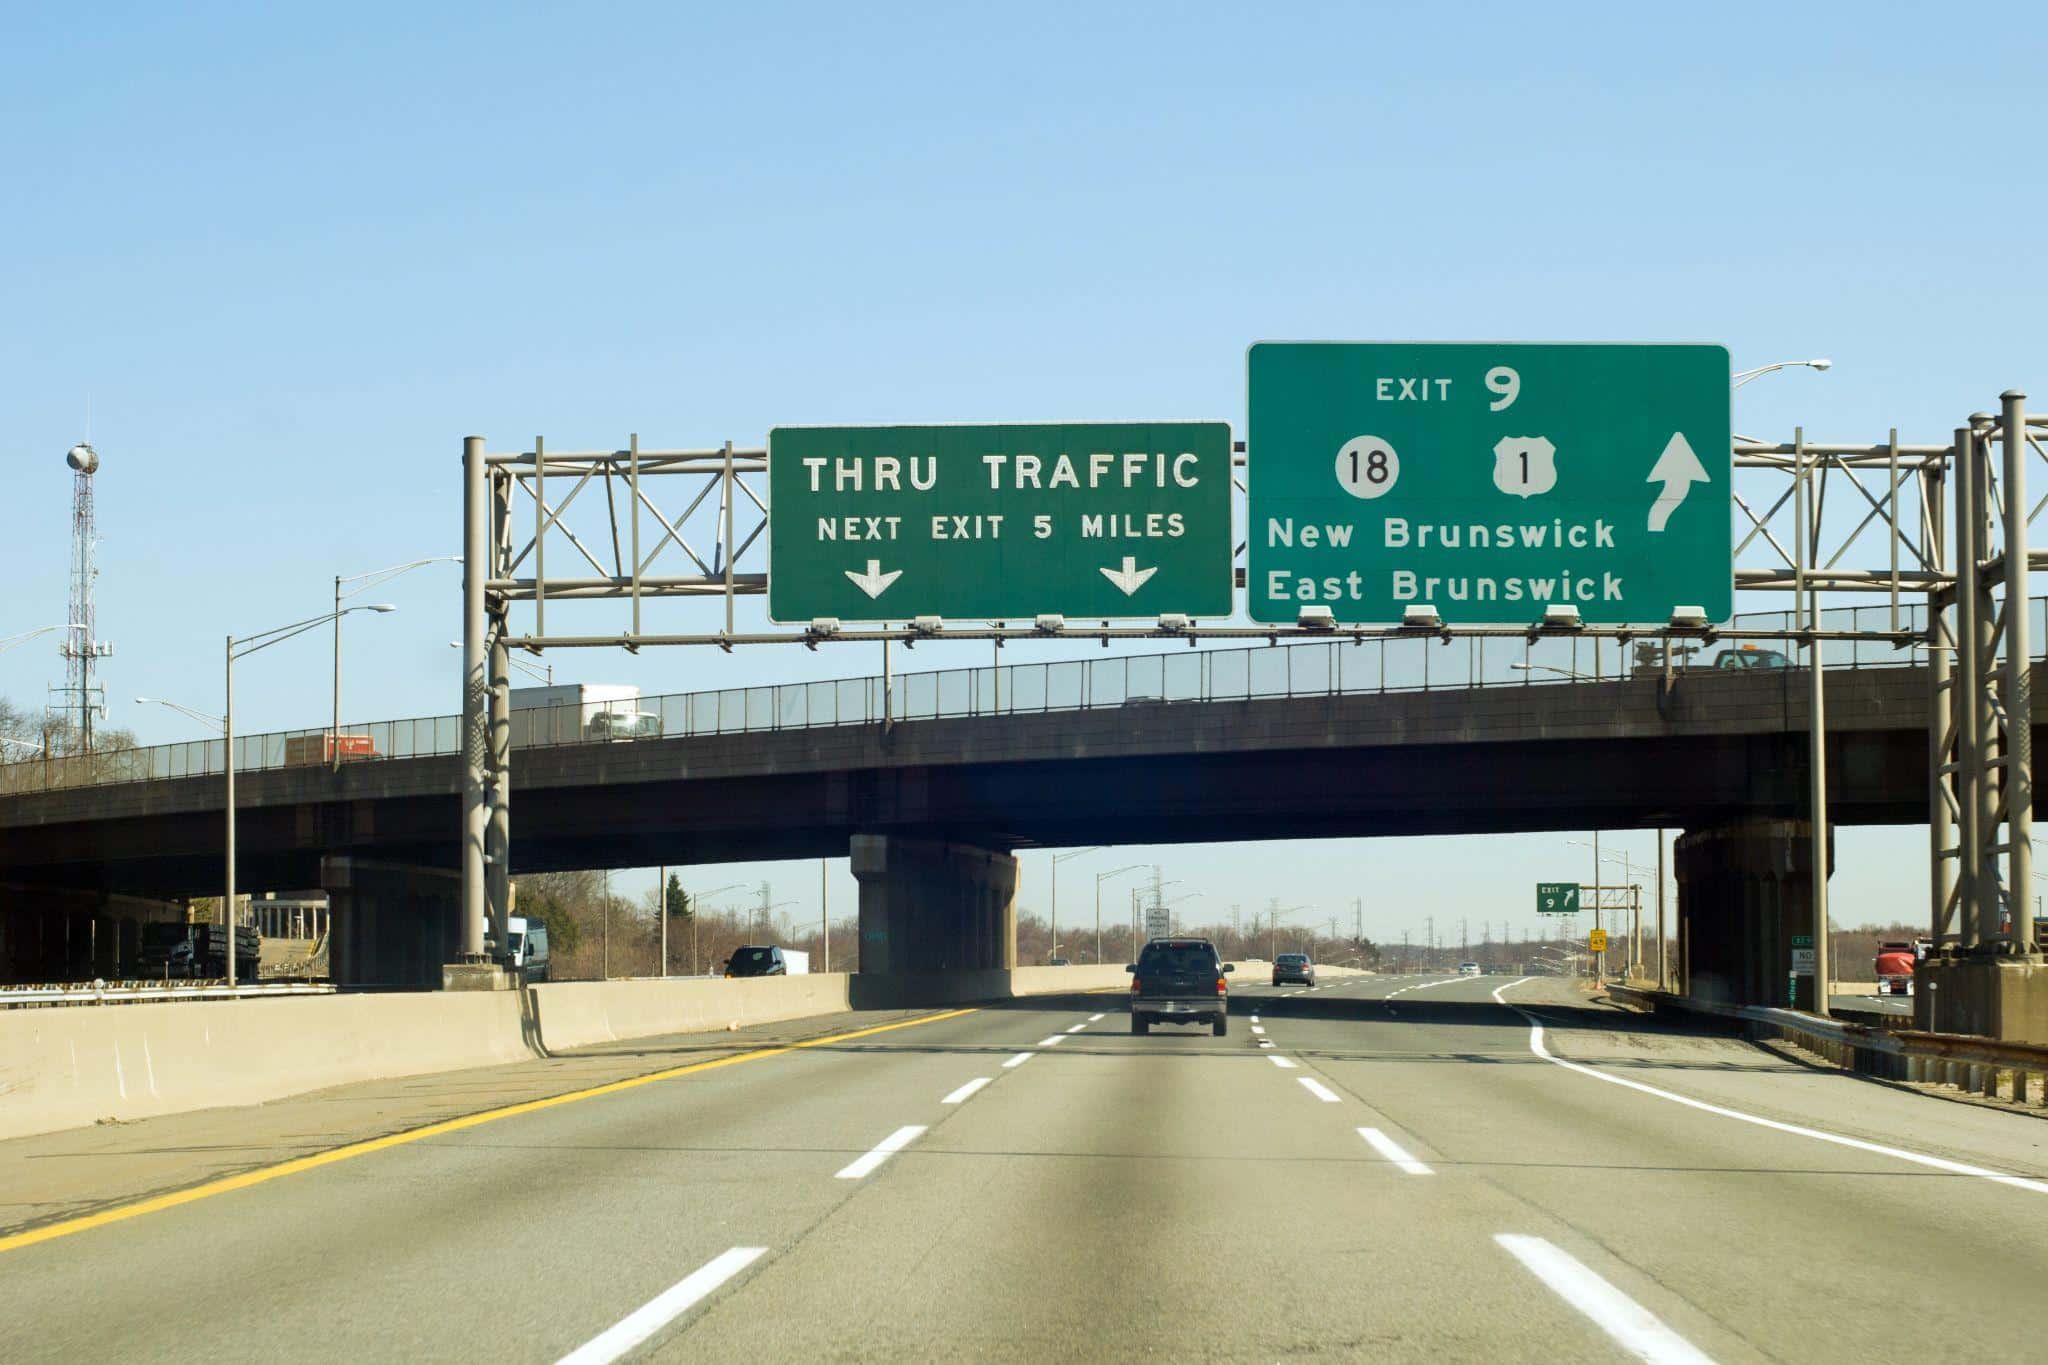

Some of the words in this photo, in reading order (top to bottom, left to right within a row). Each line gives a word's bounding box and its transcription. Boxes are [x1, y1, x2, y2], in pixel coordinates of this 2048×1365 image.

[1376, 378, 1452, 401] EXIT
[1485, 366, 1521, 412] 9
[802, 456, 937, 491] THRU
[982, 453, 1199, 489] TRAFFIC
[1348, 450, 1389, 484] 18
[1518, 451, 1529, 484] 1
[818, 517, 902, 541] NEXT
[931, 515, 1004, 540] EXIT
[1034, 515, 1052, 539] 5
[1081, 513, 1185, 538] MILES
[1268, 518, 1354, 548] New
[1384, 517, 1615, 548] Brunswick
[1268, 570, 1363, 600] East
[1393, 569, 1624, 601] Brunswick
[1546, 898, 1555, 908] 9
